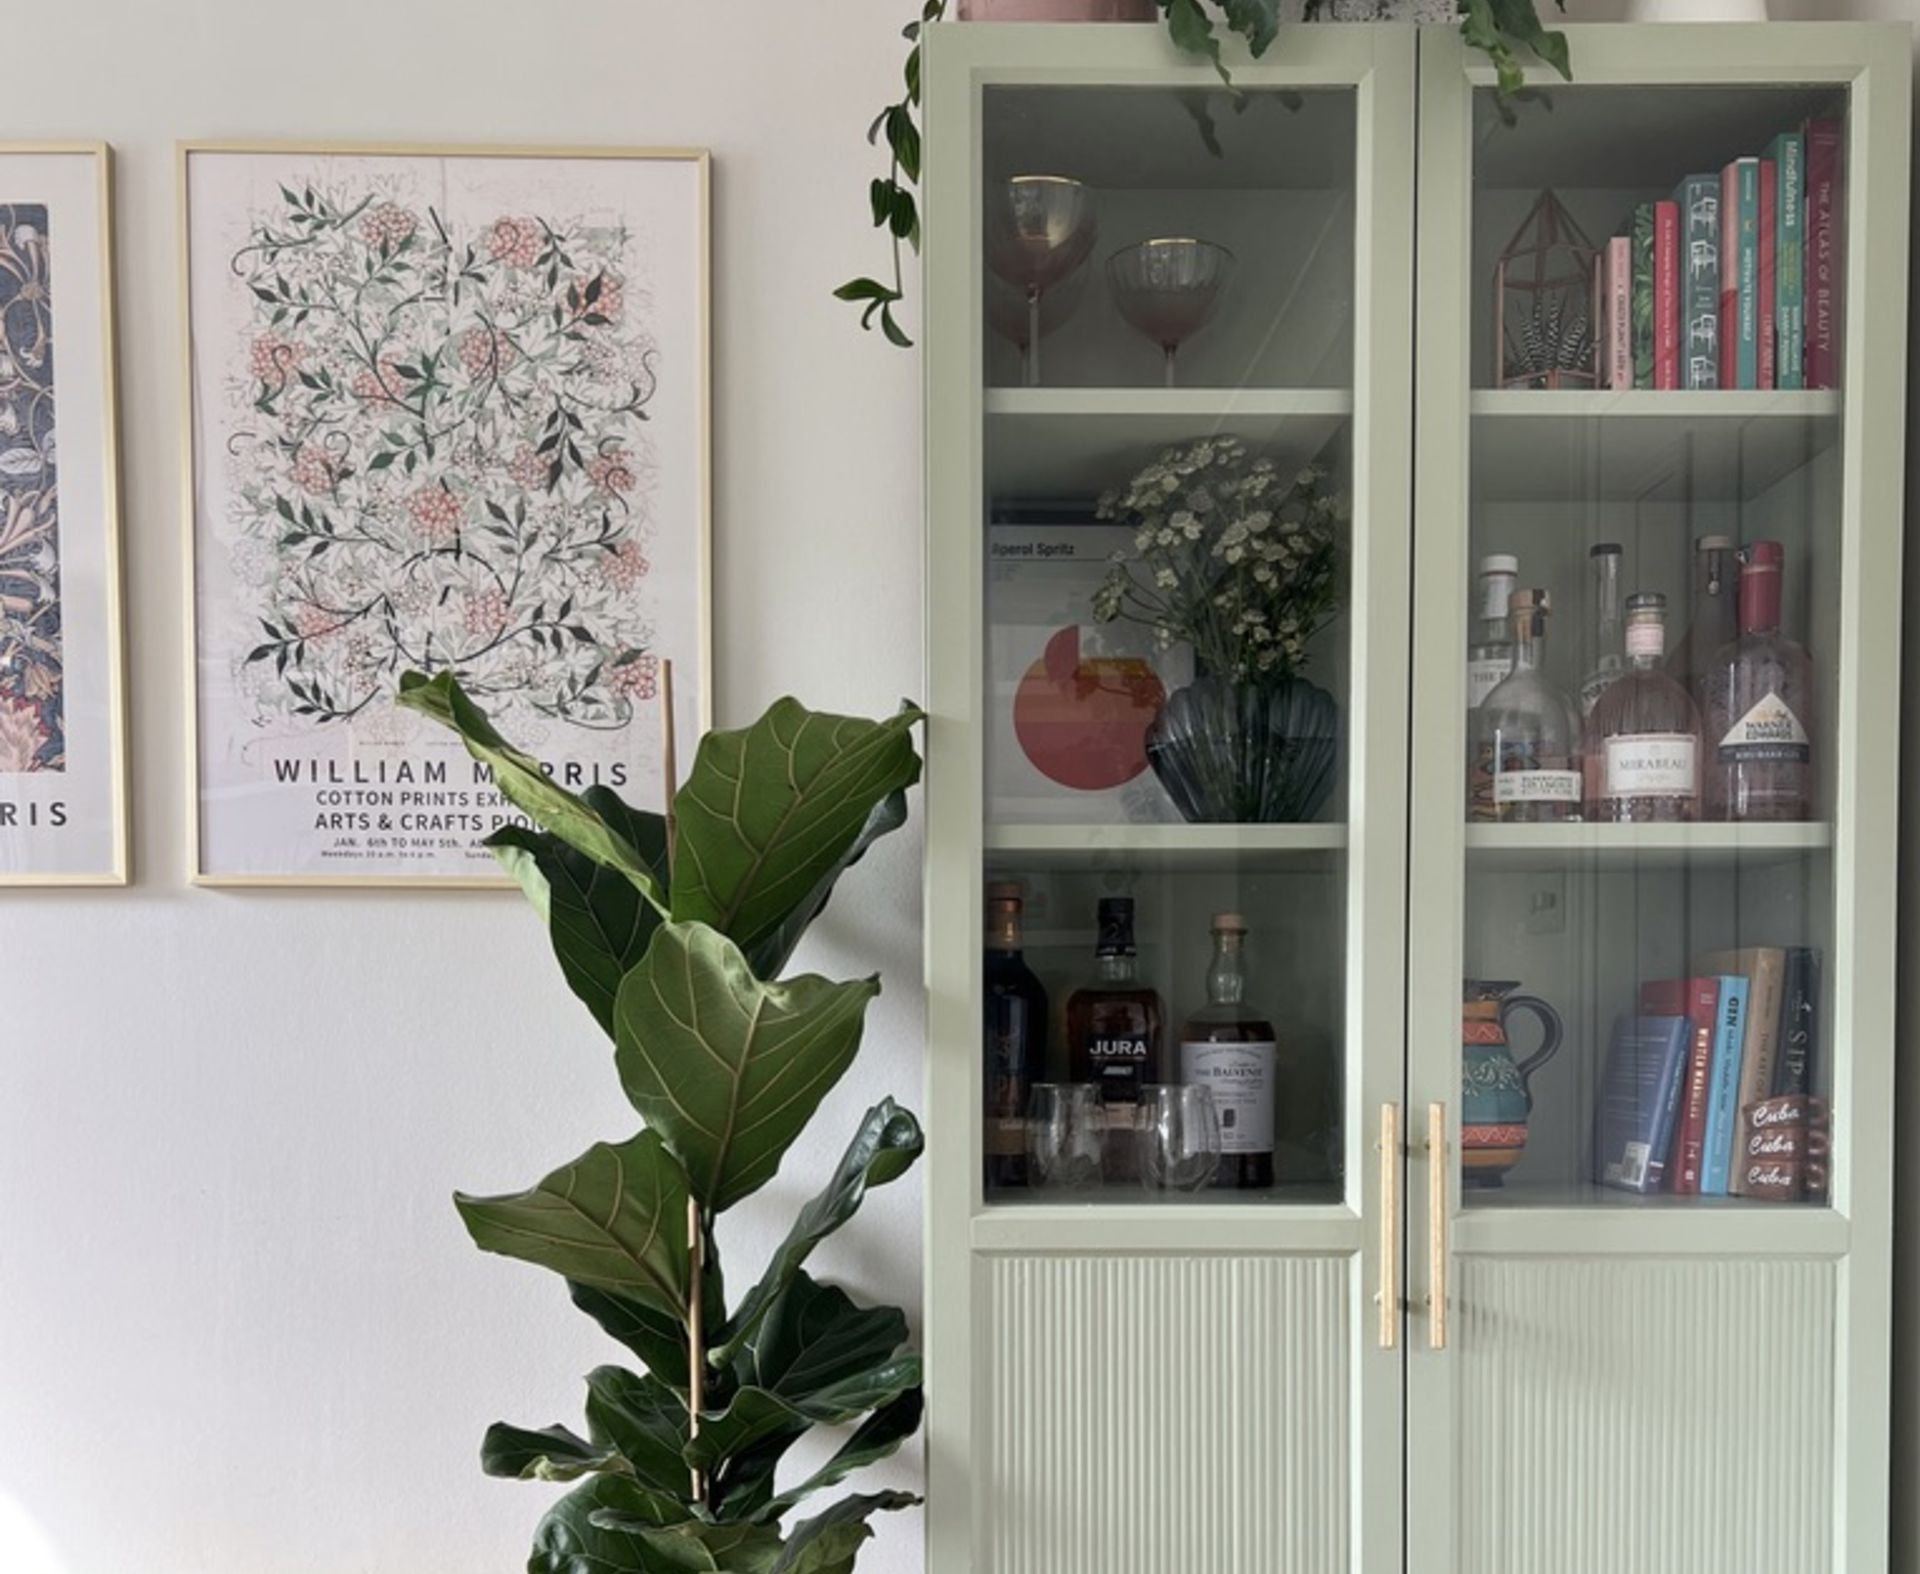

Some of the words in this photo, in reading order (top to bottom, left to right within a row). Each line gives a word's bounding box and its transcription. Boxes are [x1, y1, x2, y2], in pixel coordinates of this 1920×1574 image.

[1784, 140, 1798, 227] Mindfulness
[1818, 208, 1830, 260] ATLAS
[1817, 288, 1830, 351] BEAUTY
[1037, 542, 1075, 557] Spritz
[273, 760, 447, 783] WILLIAM
[1619, 758, 1687, 770] MIRABEAU
[316, 790, 394, 806] COTTON
[400, 791, 469, 807] PRINTS
[314, 813, 371, 831] ARTS
[377, 813, 393, 831] &
[399, 814, 483, 832] CRAFTS
[333, 839, 361, 848] JAN.
[367, 838, 387, 848] 6th
[391, 839, 408, 848] TO
[412, 839, 434, 848] MAY
[1725, 996, 1739, 1027] GIN
[1089, 1040, 1147, 1055] JURA
[1785, 1029, 1807, 1076] SIP
[1212, 1066, 1263, 1077] BALVENIE
[1752, 1103, 1799, 1128] Cuba
[1748, 1134, 1795, 1155] Cuba
[1747, 1165, 1792, 1186] Cuba
